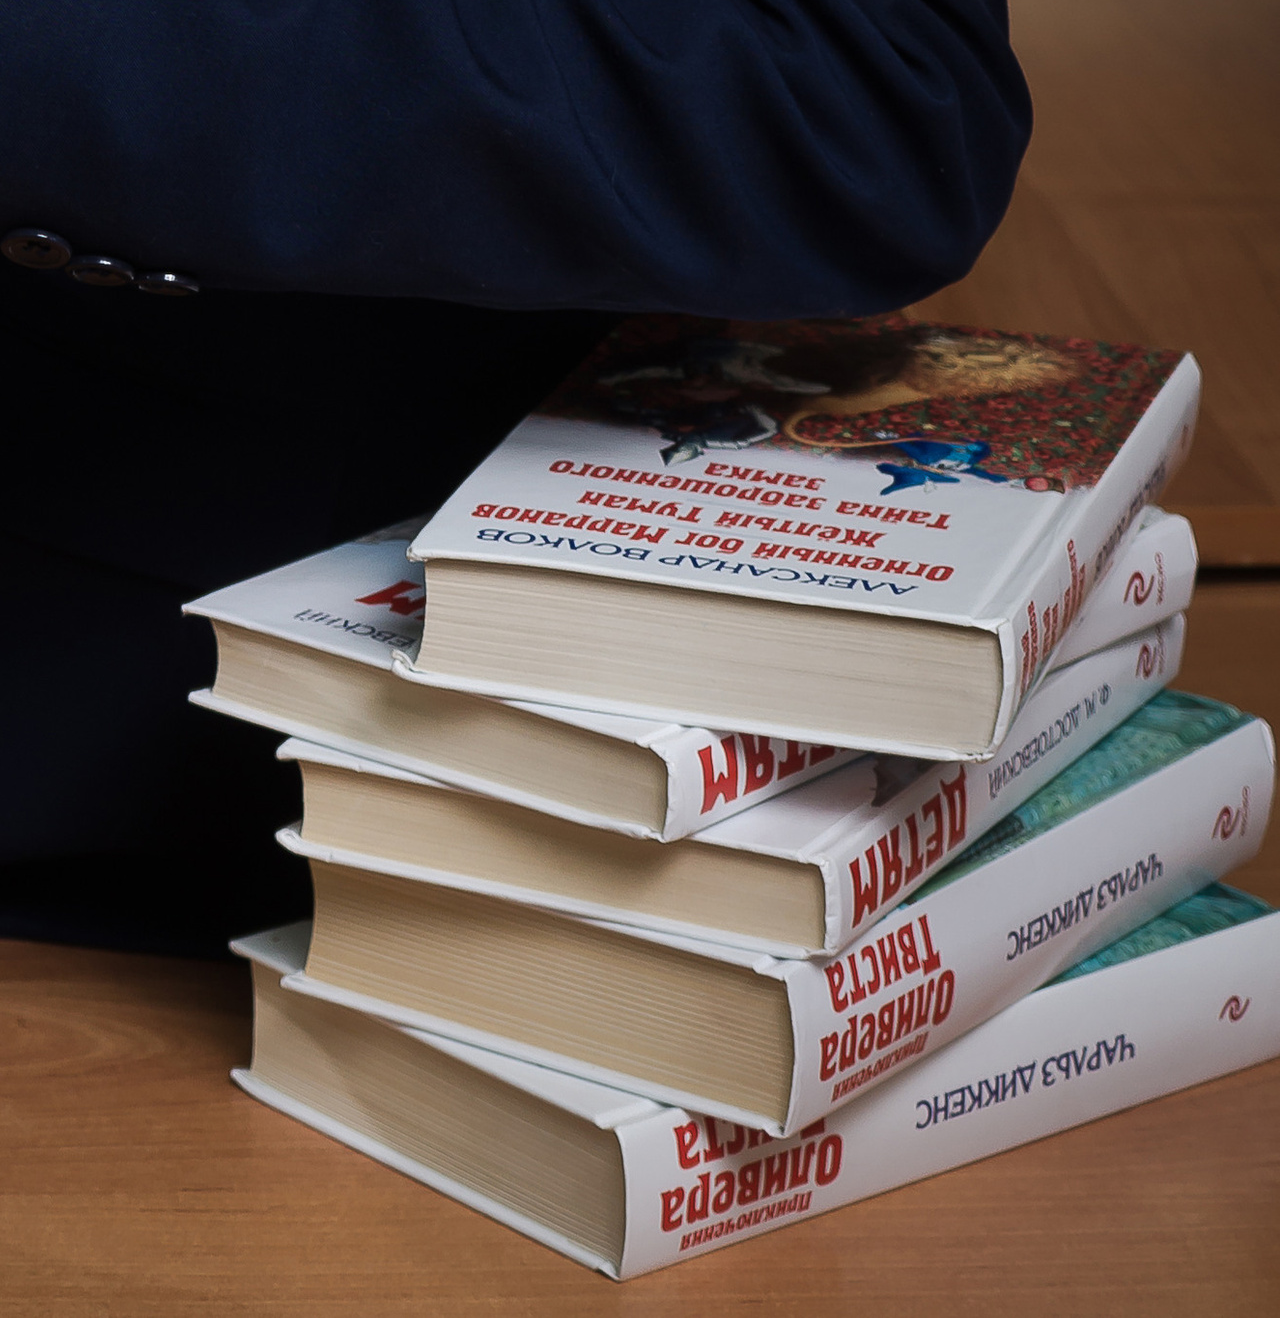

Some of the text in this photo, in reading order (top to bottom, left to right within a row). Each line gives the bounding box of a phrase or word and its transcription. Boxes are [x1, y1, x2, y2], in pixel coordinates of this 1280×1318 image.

[548, 457, 952, 533] Тайна заброшенного
[576, 487, 887, 552] Жёлтый Туман
[702, 461, 827, 494] замка
[470, 501, 956, 584] Огненный бог Марранов
[475, 526, 919, 597] АЛЕКСАНДР ВОЛКОВ
[985, 703, 1082, 800] ДОСТОЕВСКИЙ
[847, 767, 969, 928] ДЕТЯМ
[1005, 852, 1163, 962] ЧАРЛЬЗ ДИККЕНС
[822, 913, 942, 1014] Твиста
[818, 966, 956, 1084] Оливера
[829, 1030, 930, 1103] Приключения
[913, 1032, 1136, 1131] ЧАРЛЬЗ ДИККЕНС
[659, 1134, 843, 1233] Оливера
[678, 1191, 812, 1252] Приключения
